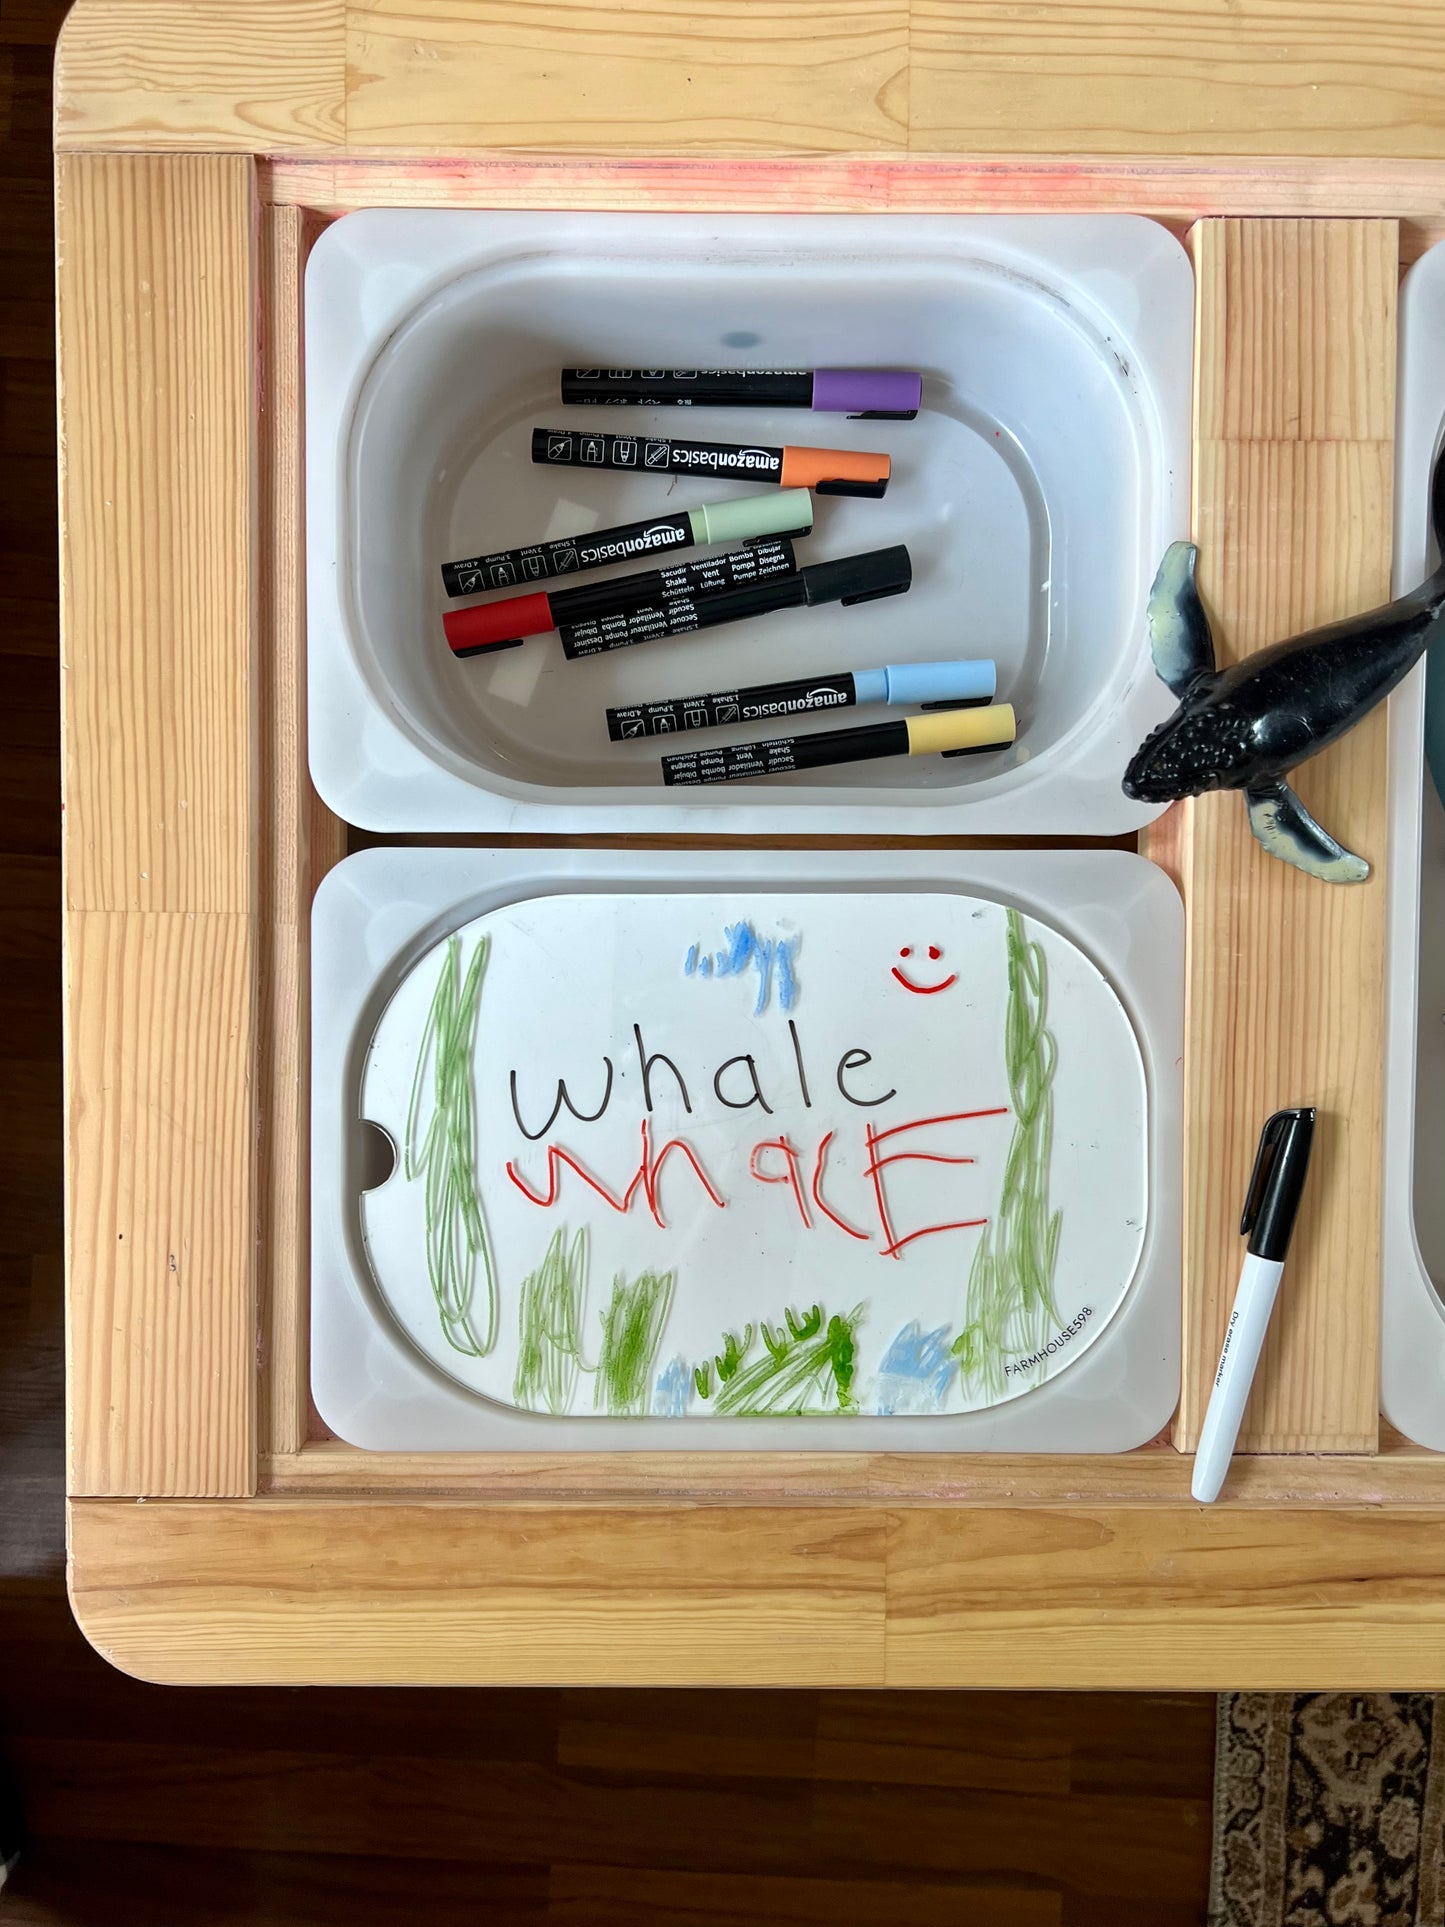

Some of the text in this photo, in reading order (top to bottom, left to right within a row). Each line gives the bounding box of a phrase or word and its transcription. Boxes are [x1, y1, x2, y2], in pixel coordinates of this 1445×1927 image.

[673, 449, 779, 470] amazonbasics
[454, 539, 576, 570] 1.Shake 2.Vent 3.Pump 4.Draw
[581, 526, 685, 564] amazonbasics
[661, 568, 686, 578] Sacudir
[691, 558, 726, 571] Ventilador
[729, 552, 753, 562] Bomba
[758, 545, 781, 555] Dibujar
[666, 554, 784, 587] Shake Vent Pompa Disegna
[662, 586, 694, 598] Schütteln
[700, 578, 725, 588] Lüftung
[734, 571, 756, 580] Pumpe
[758, 562, 789, 575] Zeichnen
[574, 604, 694, 637] Sacudir Ventilador Bomba Dibujar
[574, 614, 698, 648] Secouer Ventilateur Pompe Dessiner
[673, 624, 698, 633] 1.Shake
[616, 710, 641, 718] 4.Draw
[648, 705, 673, 714] 3.Pump
[684, 700, 704, 708] 2.Vent
[713, 695, 739, 704] 1.Shake
[743, 688, 847, 719] amazonbasics
[667, 753, 697, 762] Zeichnen
[671, 746, 790, 770] Shake Vent Pompa Disegna
[673, 755, 794, 780] Sacudir Ventilador Bomba Dibujar
[509, 1018, 898, 1141] whale
[1004, 1307, 1092, 1377] FARMHOUSE598
[1216, 1311, 1239, 1387] Dry erase marker
